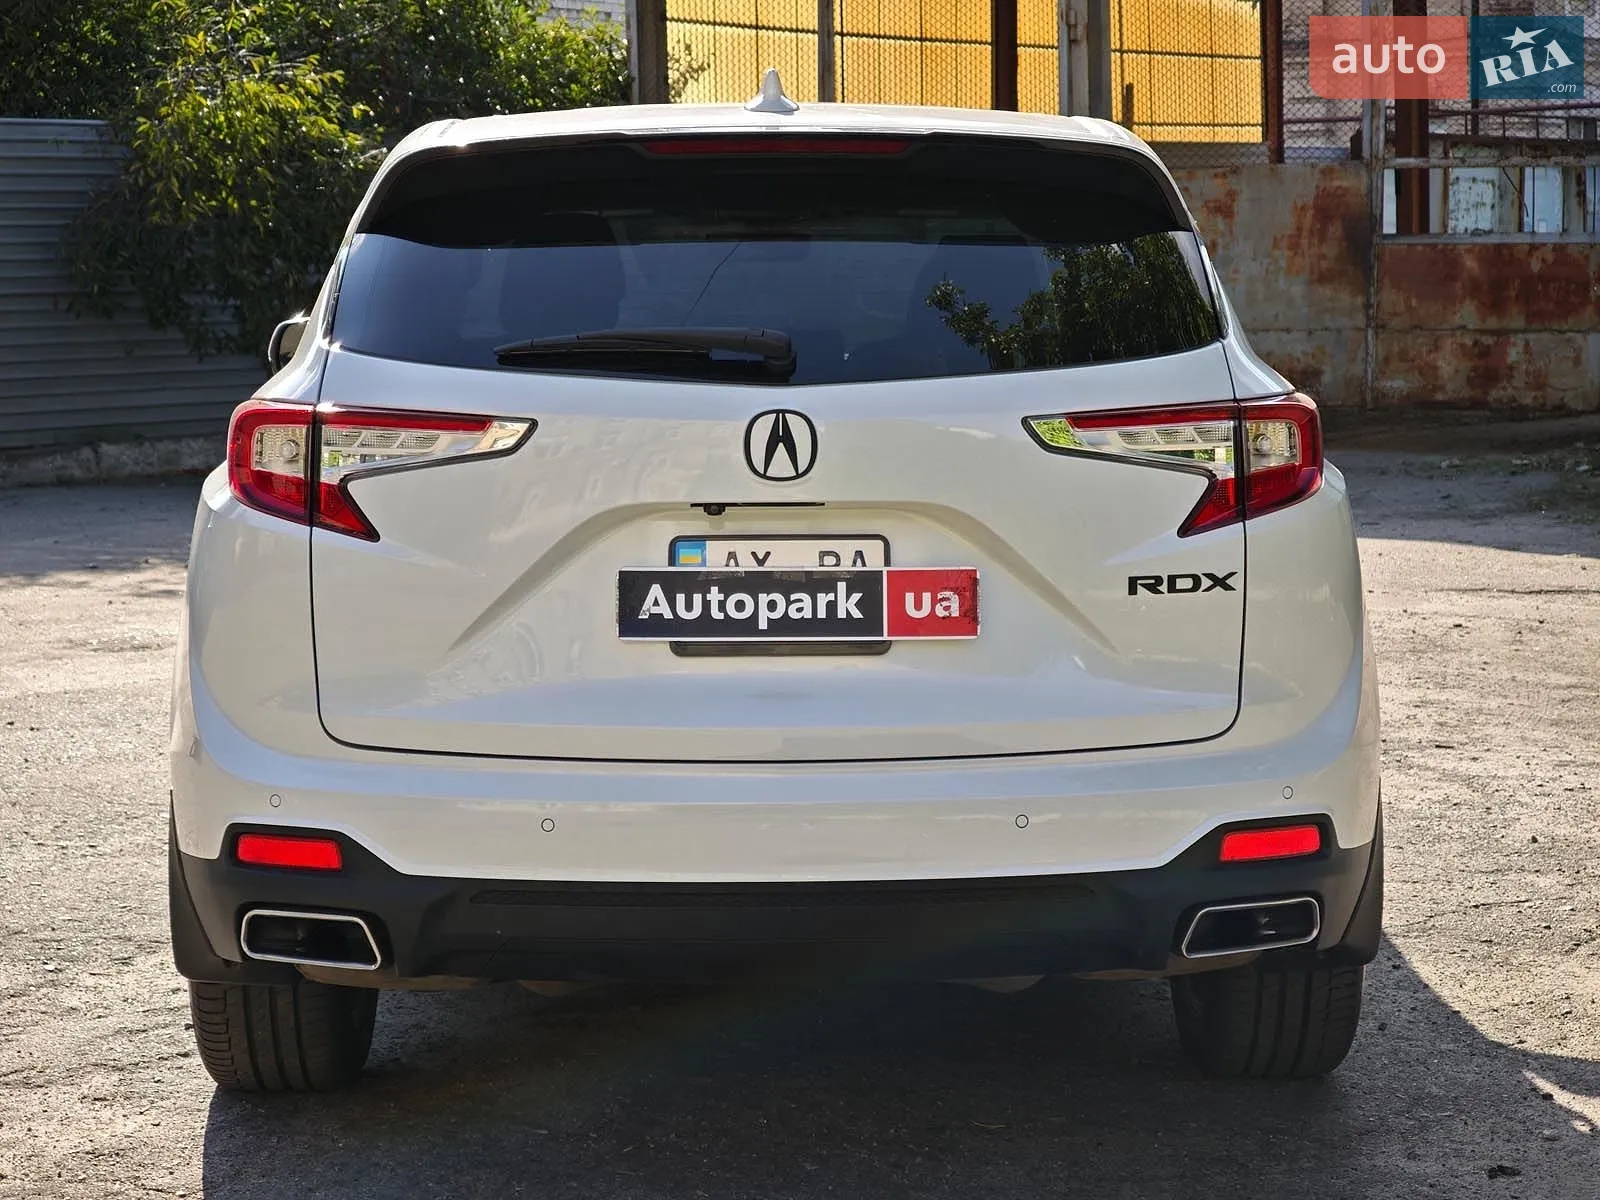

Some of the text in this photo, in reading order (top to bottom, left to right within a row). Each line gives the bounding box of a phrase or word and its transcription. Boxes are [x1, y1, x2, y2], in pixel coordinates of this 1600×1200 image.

[1127, 571, 1239, 596] RDX
[637, 581, 961, 630] Autopark ua
